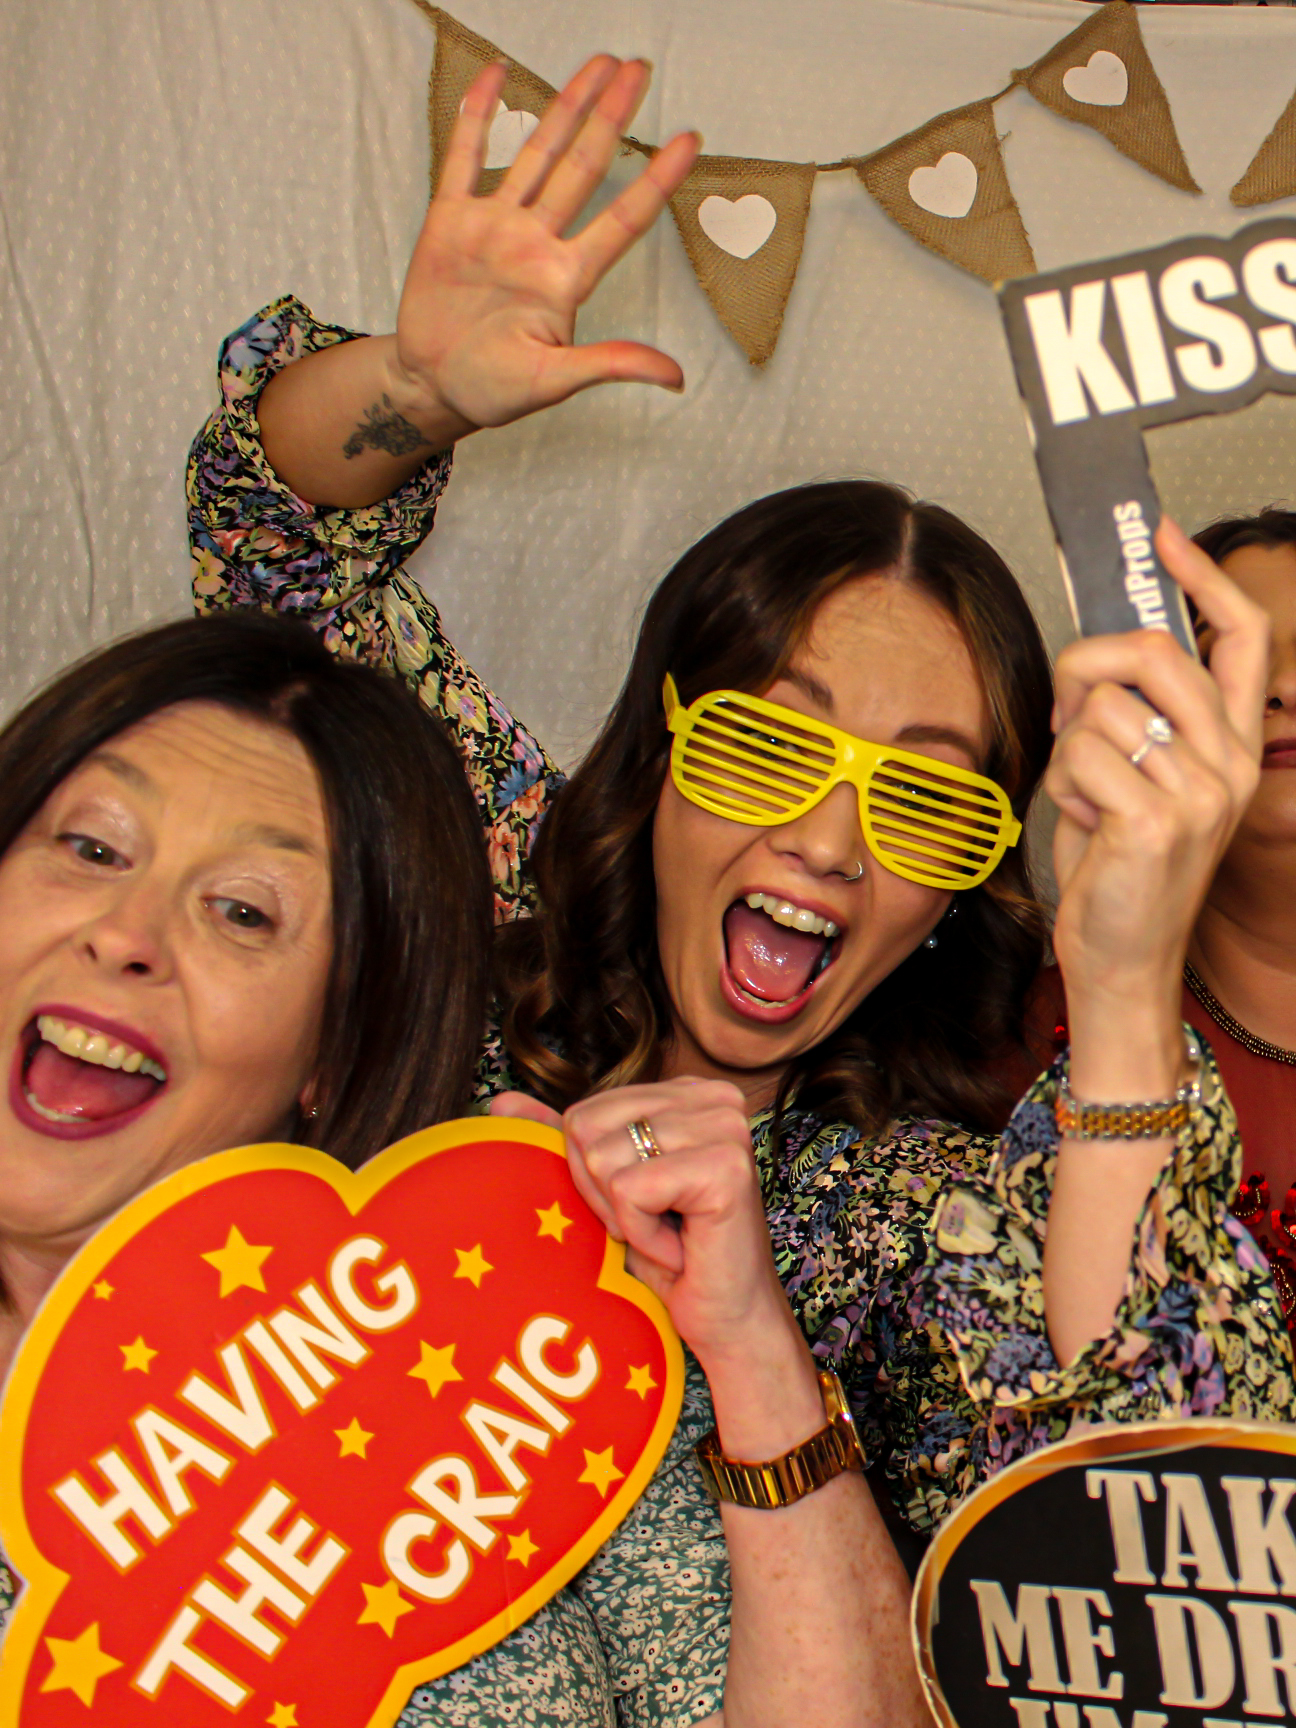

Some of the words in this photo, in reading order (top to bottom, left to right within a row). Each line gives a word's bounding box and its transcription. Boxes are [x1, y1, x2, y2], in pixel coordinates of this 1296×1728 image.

[54, 1237, 417, 1569] HAVING
[383, 1316, 598, 1600] CRAIC
[135, 1487, 348, 1708] THE
[969, 1578, 1125, 1699] ME
